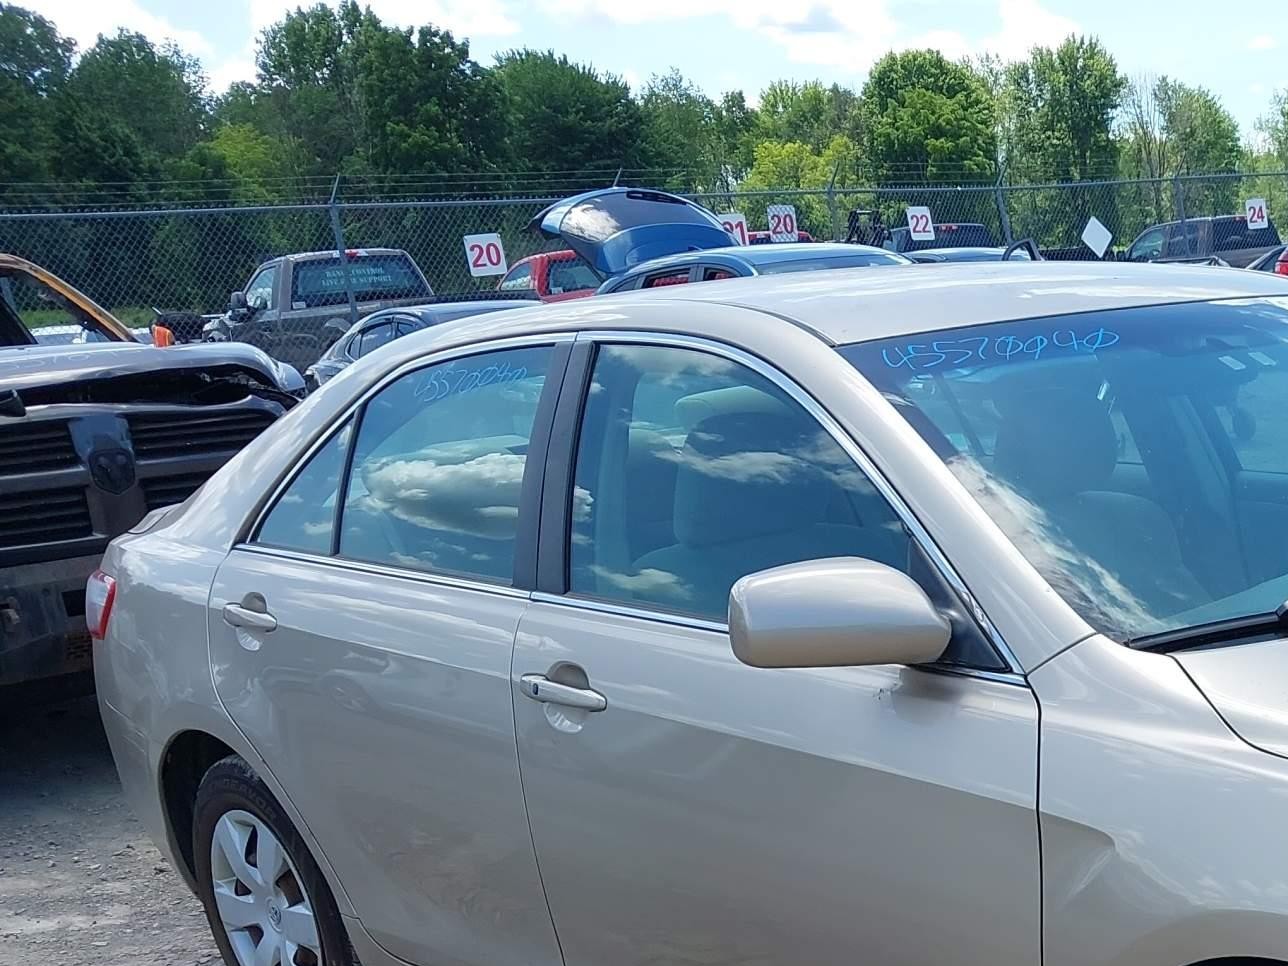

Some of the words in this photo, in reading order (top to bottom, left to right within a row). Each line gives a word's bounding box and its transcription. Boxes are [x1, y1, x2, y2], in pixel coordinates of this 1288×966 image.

[770, 213, 795, 235] 20
[910, 214, 932, 234] 22
[1248, 205, 1265, 224] 24
[469, 242, 502, 268] 20
[882, 327, 1120, 370] 45570040
